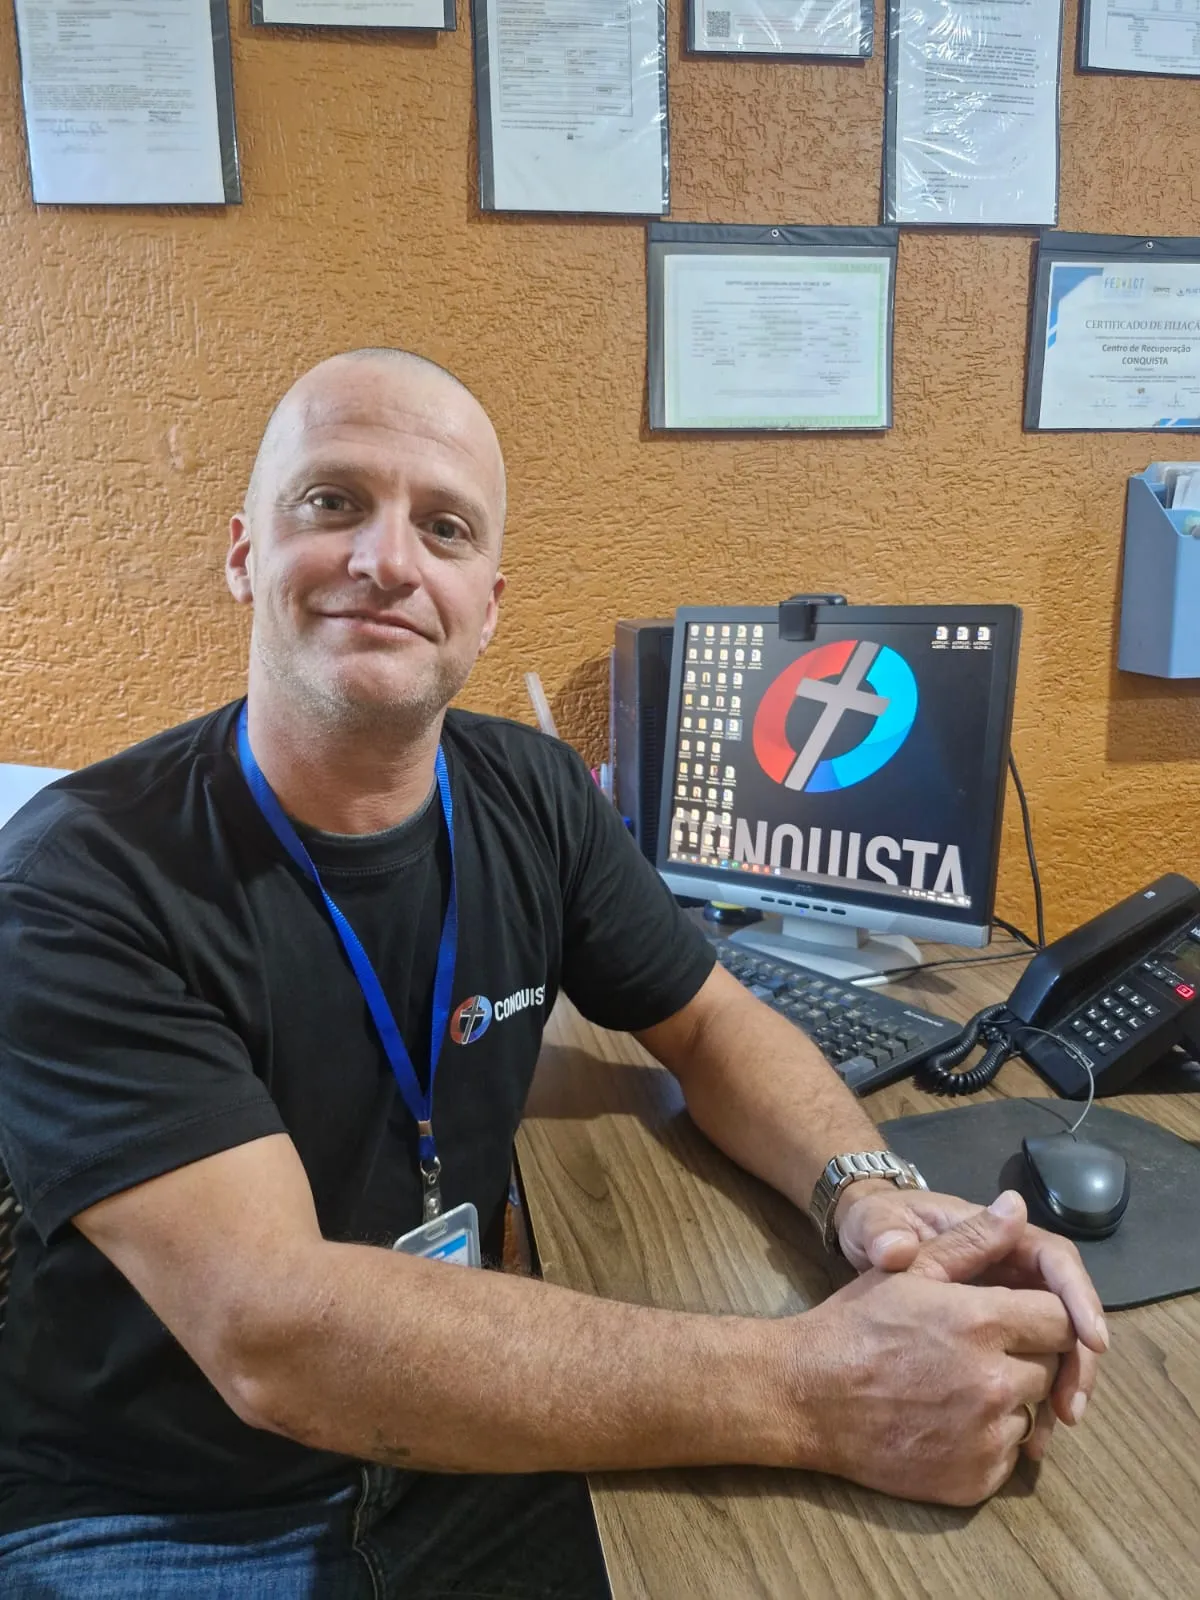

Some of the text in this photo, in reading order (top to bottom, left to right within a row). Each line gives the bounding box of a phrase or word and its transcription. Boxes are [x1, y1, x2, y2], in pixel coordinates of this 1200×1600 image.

[1085, 319, 1148, 330] CERTIFICADO
[1149, 320, 1163, 330] DE
[1102, 344, 1191, 354] Centro de Recuperação
[1121, 356, 1168, 366] CONQUISTA
